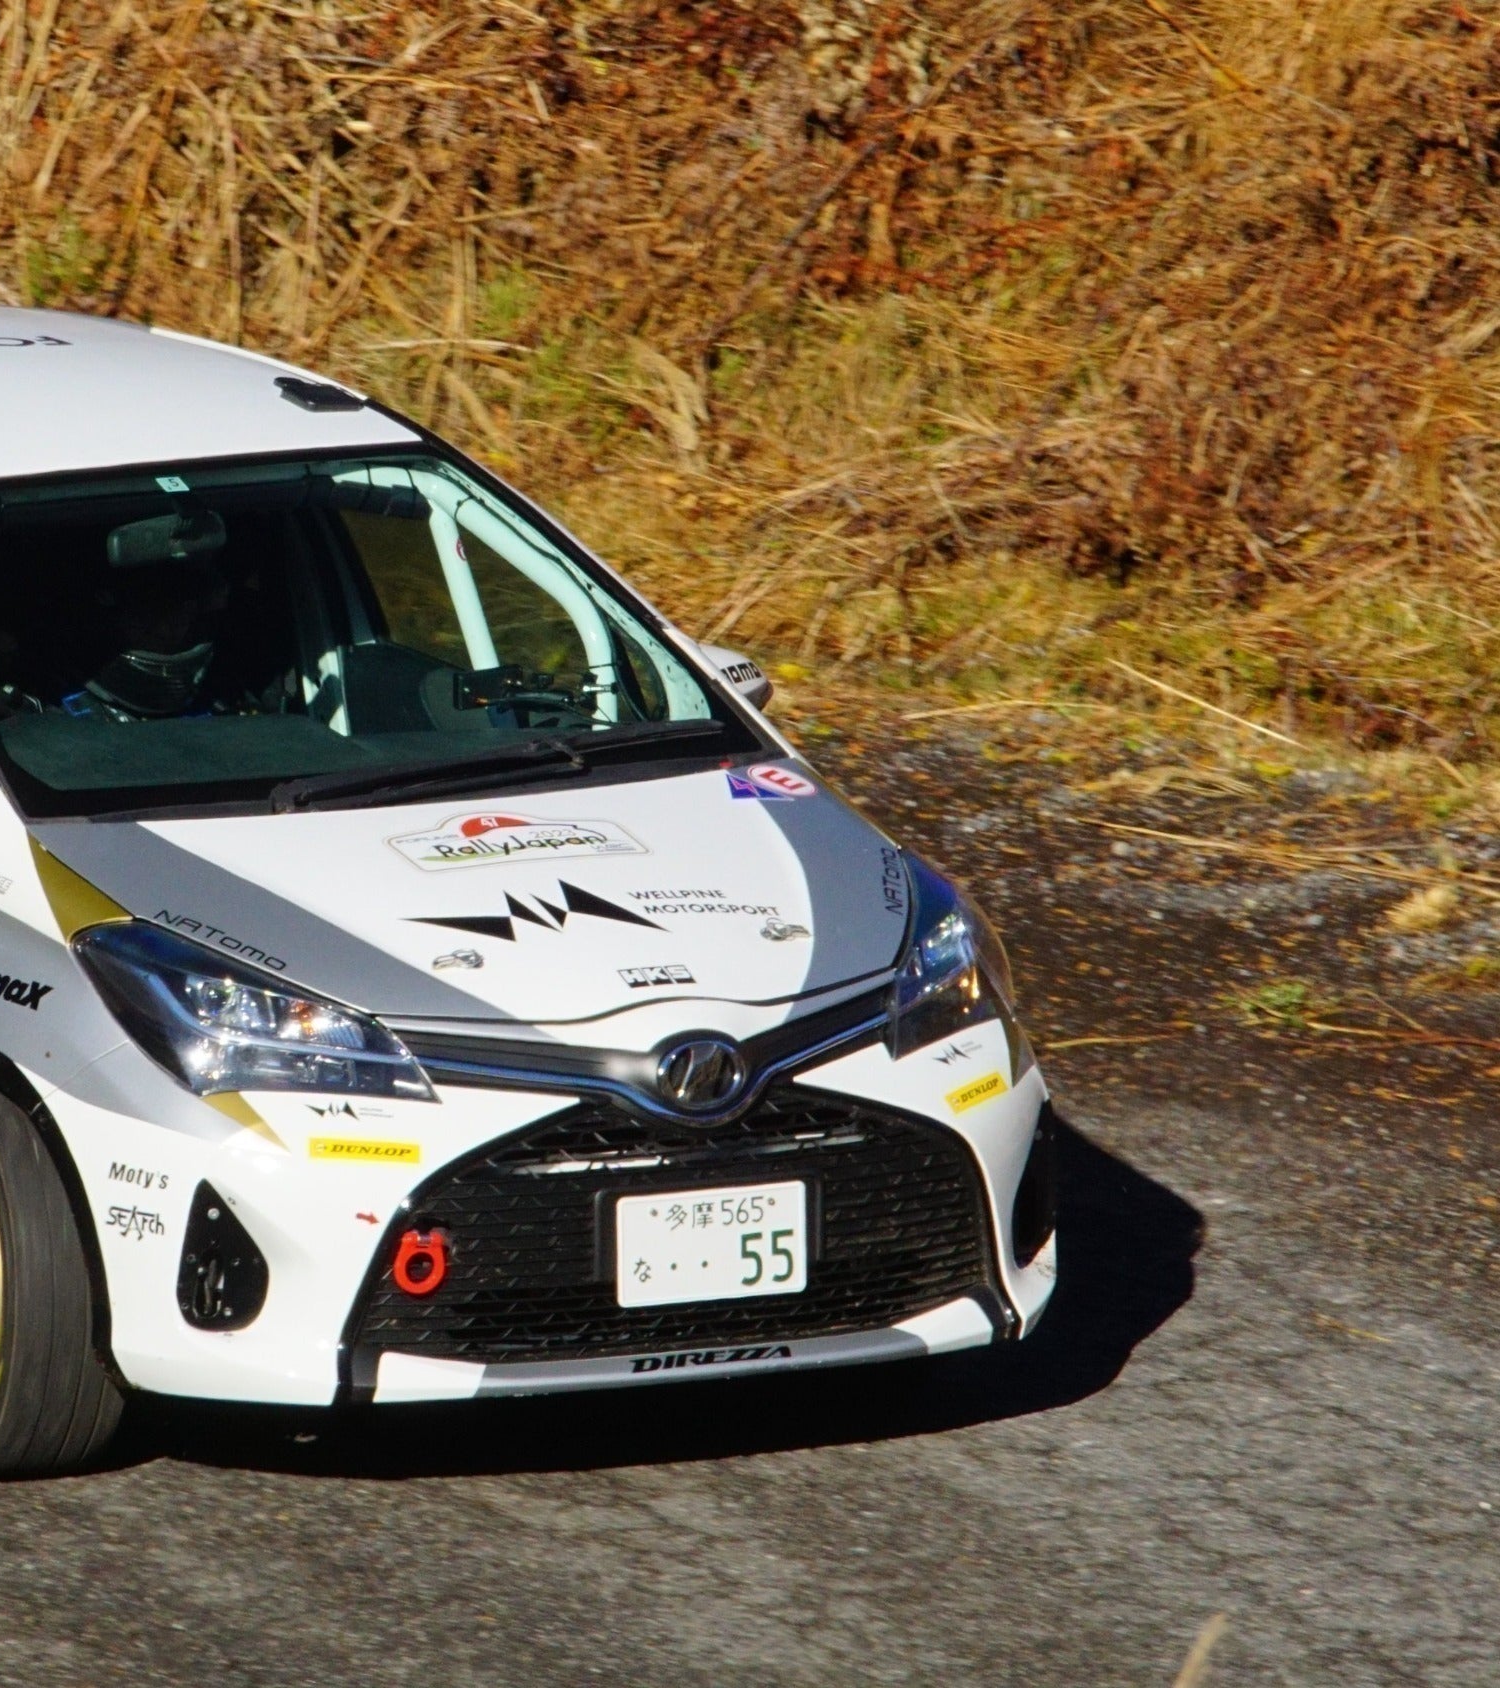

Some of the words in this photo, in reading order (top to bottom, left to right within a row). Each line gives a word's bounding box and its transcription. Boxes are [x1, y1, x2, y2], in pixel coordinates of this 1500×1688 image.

[628, 889, 727, 900] WELLPINE
[643, 903, 779, 916] MOTORSPORT
[617, 964, 697, 988] HKS
[961, 1078, 999, 1103] DUNLOP
[330, 1144, 412, 1157] DUNLOP
[108, 1162, 169, 1189] Moty's
[665, 1201, 715, 1231] 多摩
[721, 1196, 764, 1226] 565
[633, 1257, 652, 1283] な
[629, 1346, 792, 1374] DIREZZA
